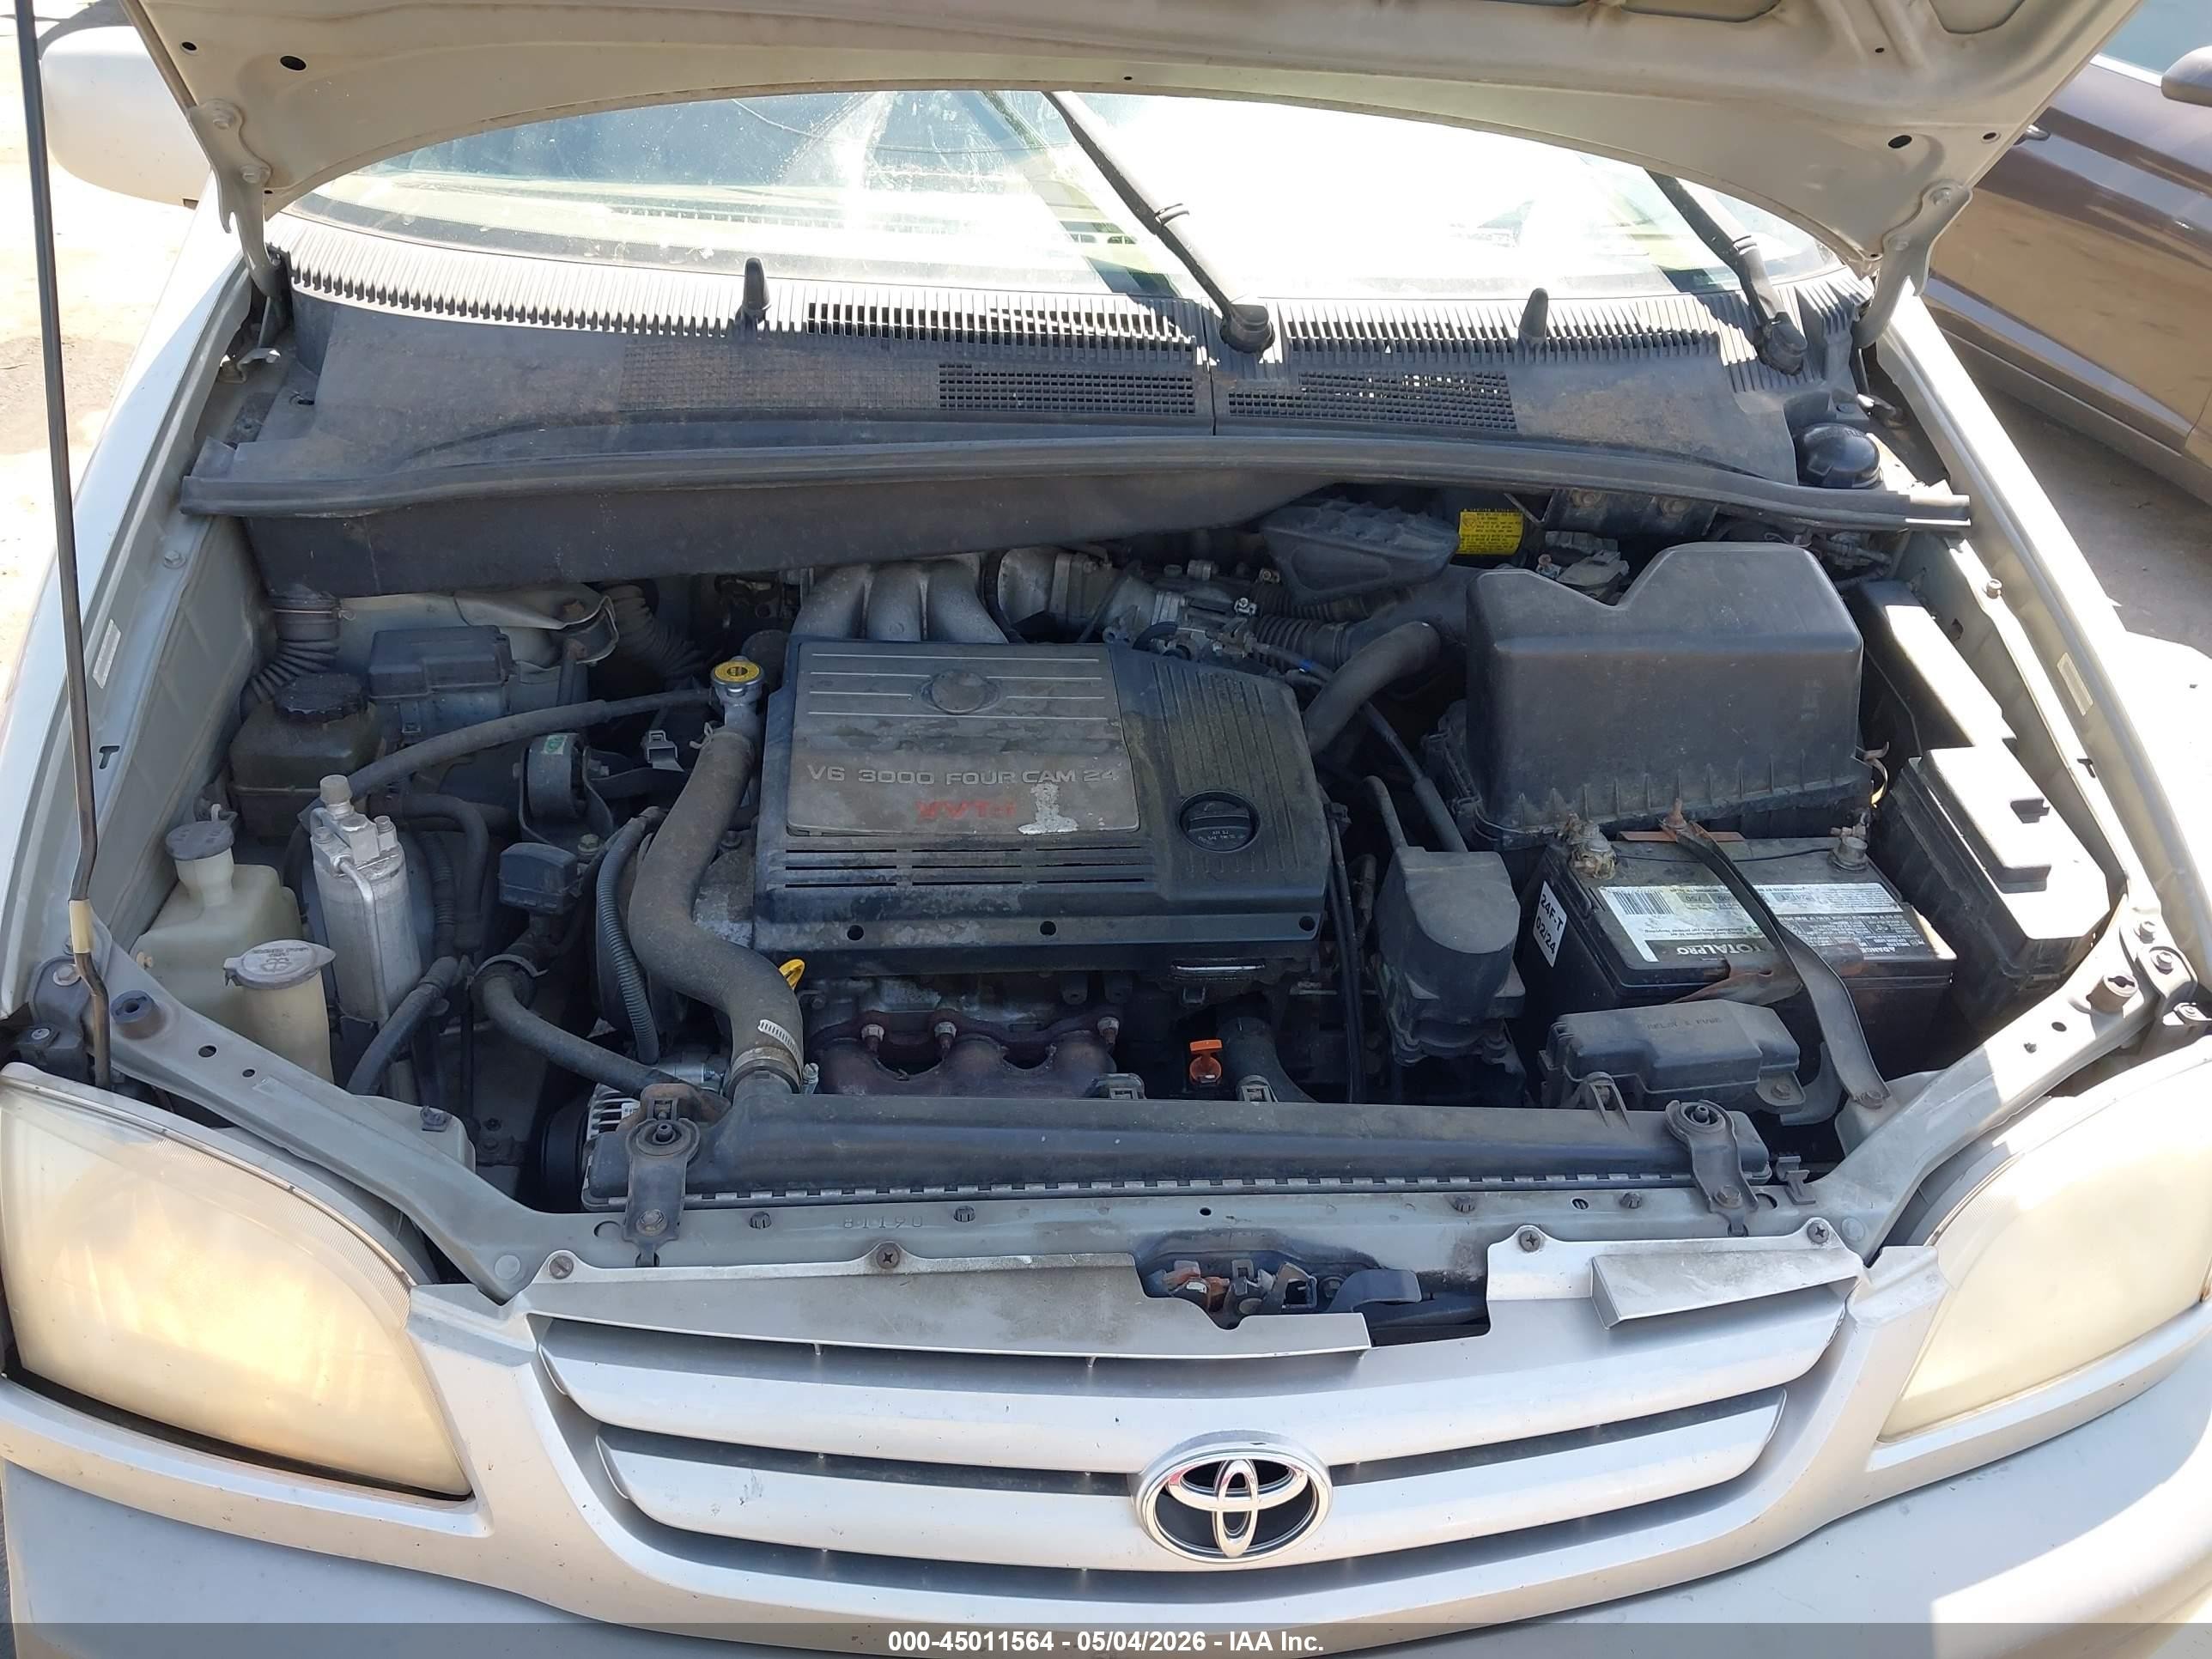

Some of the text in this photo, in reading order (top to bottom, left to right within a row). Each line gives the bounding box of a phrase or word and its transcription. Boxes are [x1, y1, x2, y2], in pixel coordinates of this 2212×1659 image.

[807, 764, 1117, 785] V6 3000 FOUR CAM 24
[1540, 894, 1564, 932] 24F-T
[1536, 916, 1556, 954] 02/24
